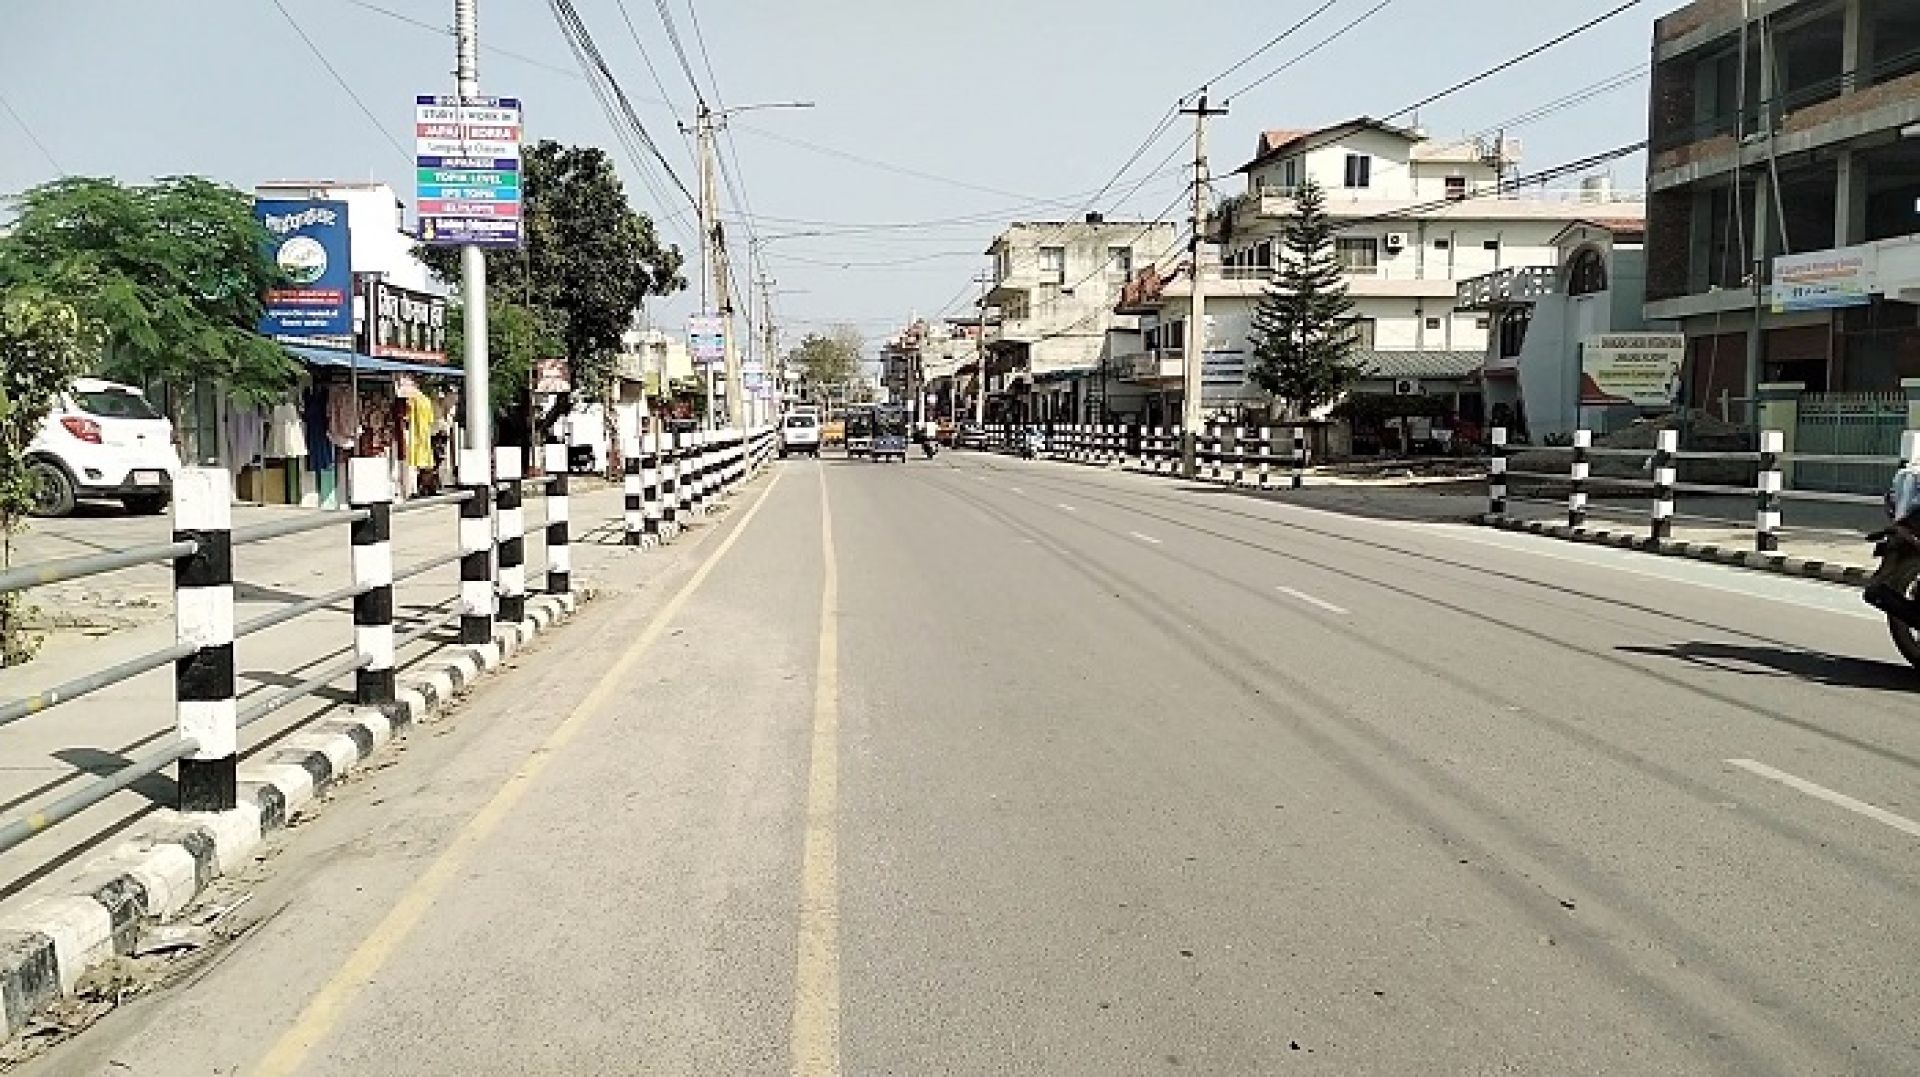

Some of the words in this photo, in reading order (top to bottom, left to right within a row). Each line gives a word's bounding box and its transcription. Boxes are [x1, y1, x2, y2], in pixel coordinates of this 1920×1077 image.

[423, 109, 454, 119] STUDY
[468, 111, 499, 121] WORK
[471, 127, 511, 138] KOREA
